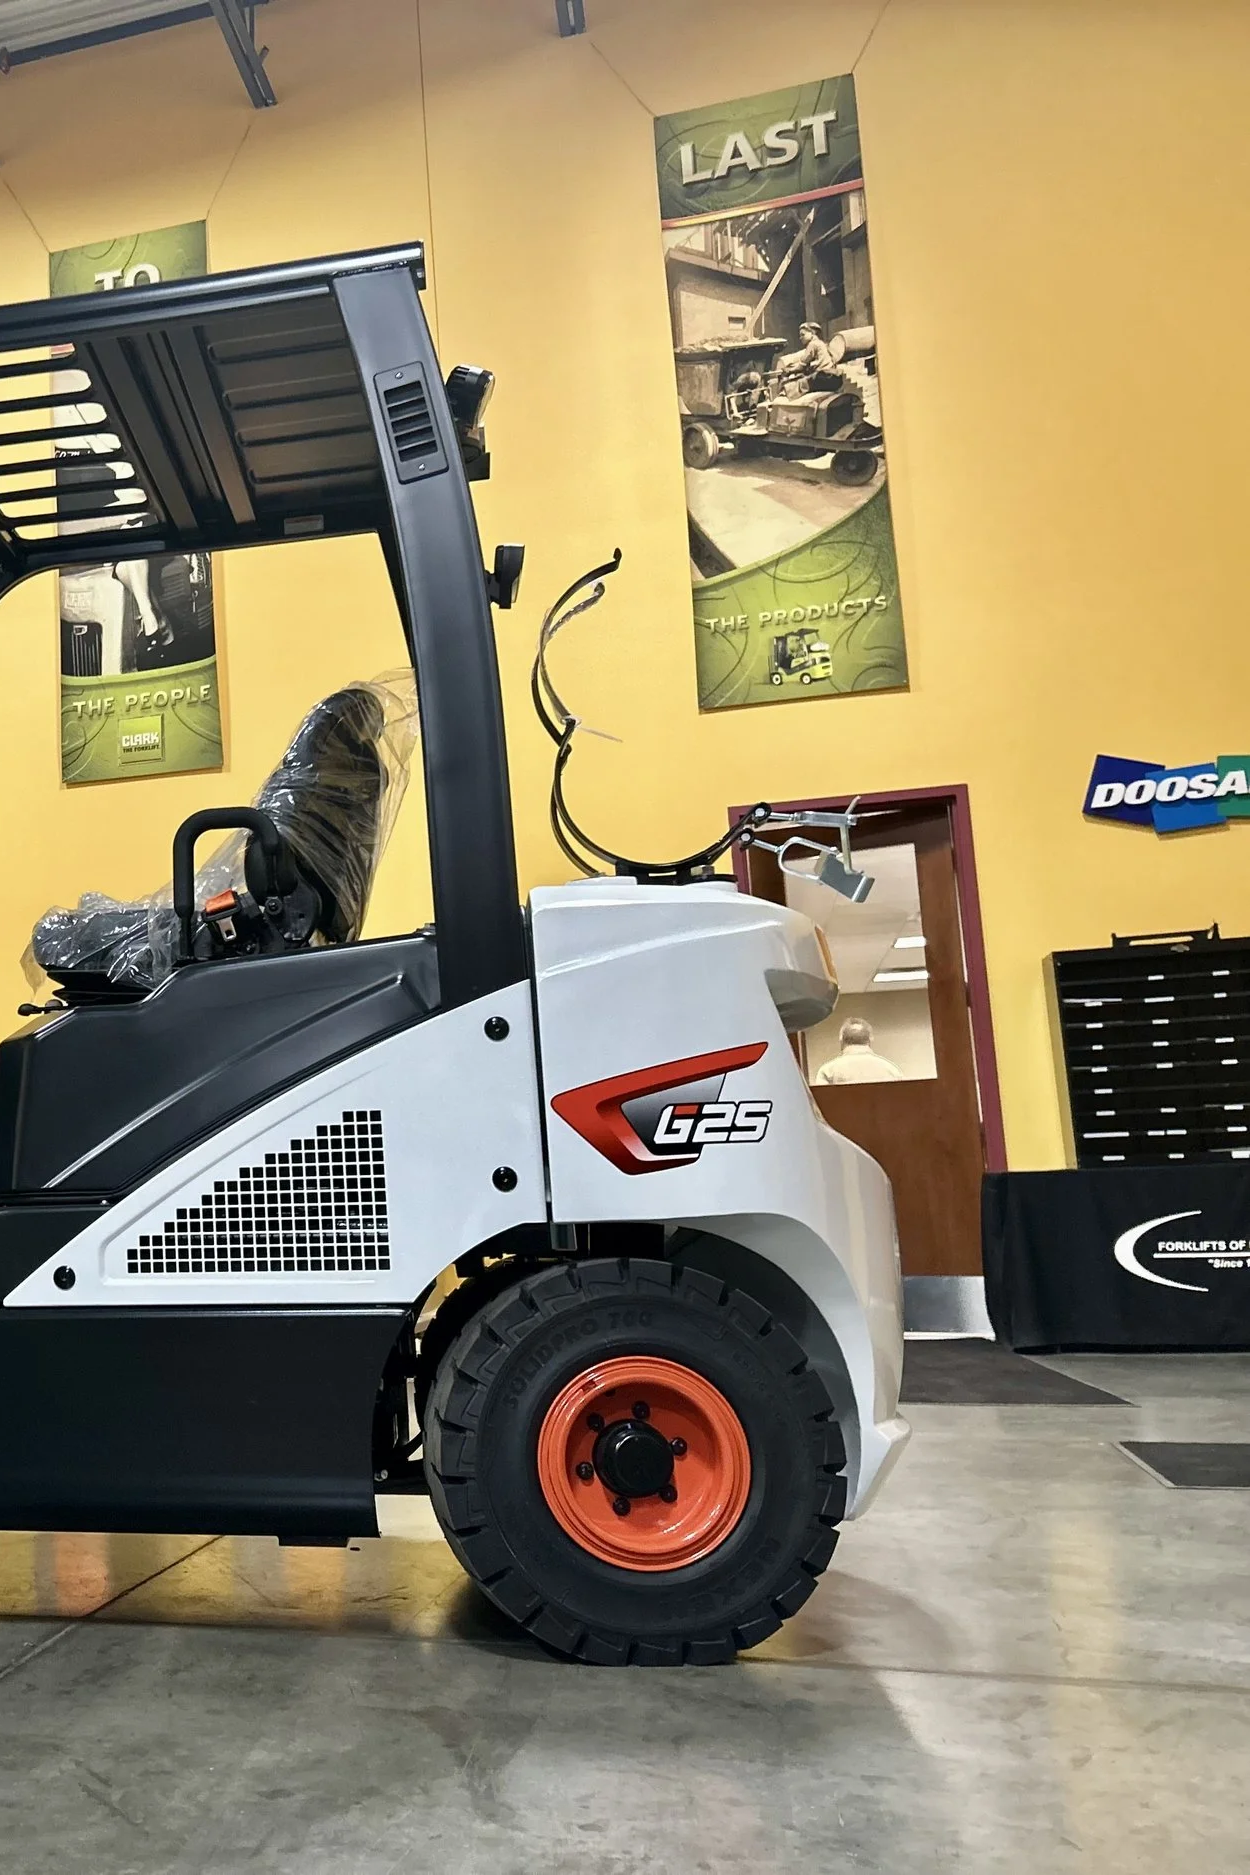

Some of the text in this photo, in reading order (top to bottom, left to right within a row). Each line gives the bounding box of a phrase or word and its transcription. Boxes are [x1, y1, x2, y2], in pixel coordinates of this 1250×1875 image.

[680, 110, 837, 185] LAST
[706, 596, 888, 632] THE PRODUCTS
[73, 685, 212, 717] THE PEOPLE
[121, 732, 160, 747] CLARK
[1091, 770, 1250, 808] DOOSA
[653, 1101, 772, 1145] G25
[1158, 1240, 1246, 1252] FORKLIFTS OF
[501, 1317, 600, 1410] SOLIDPRO
